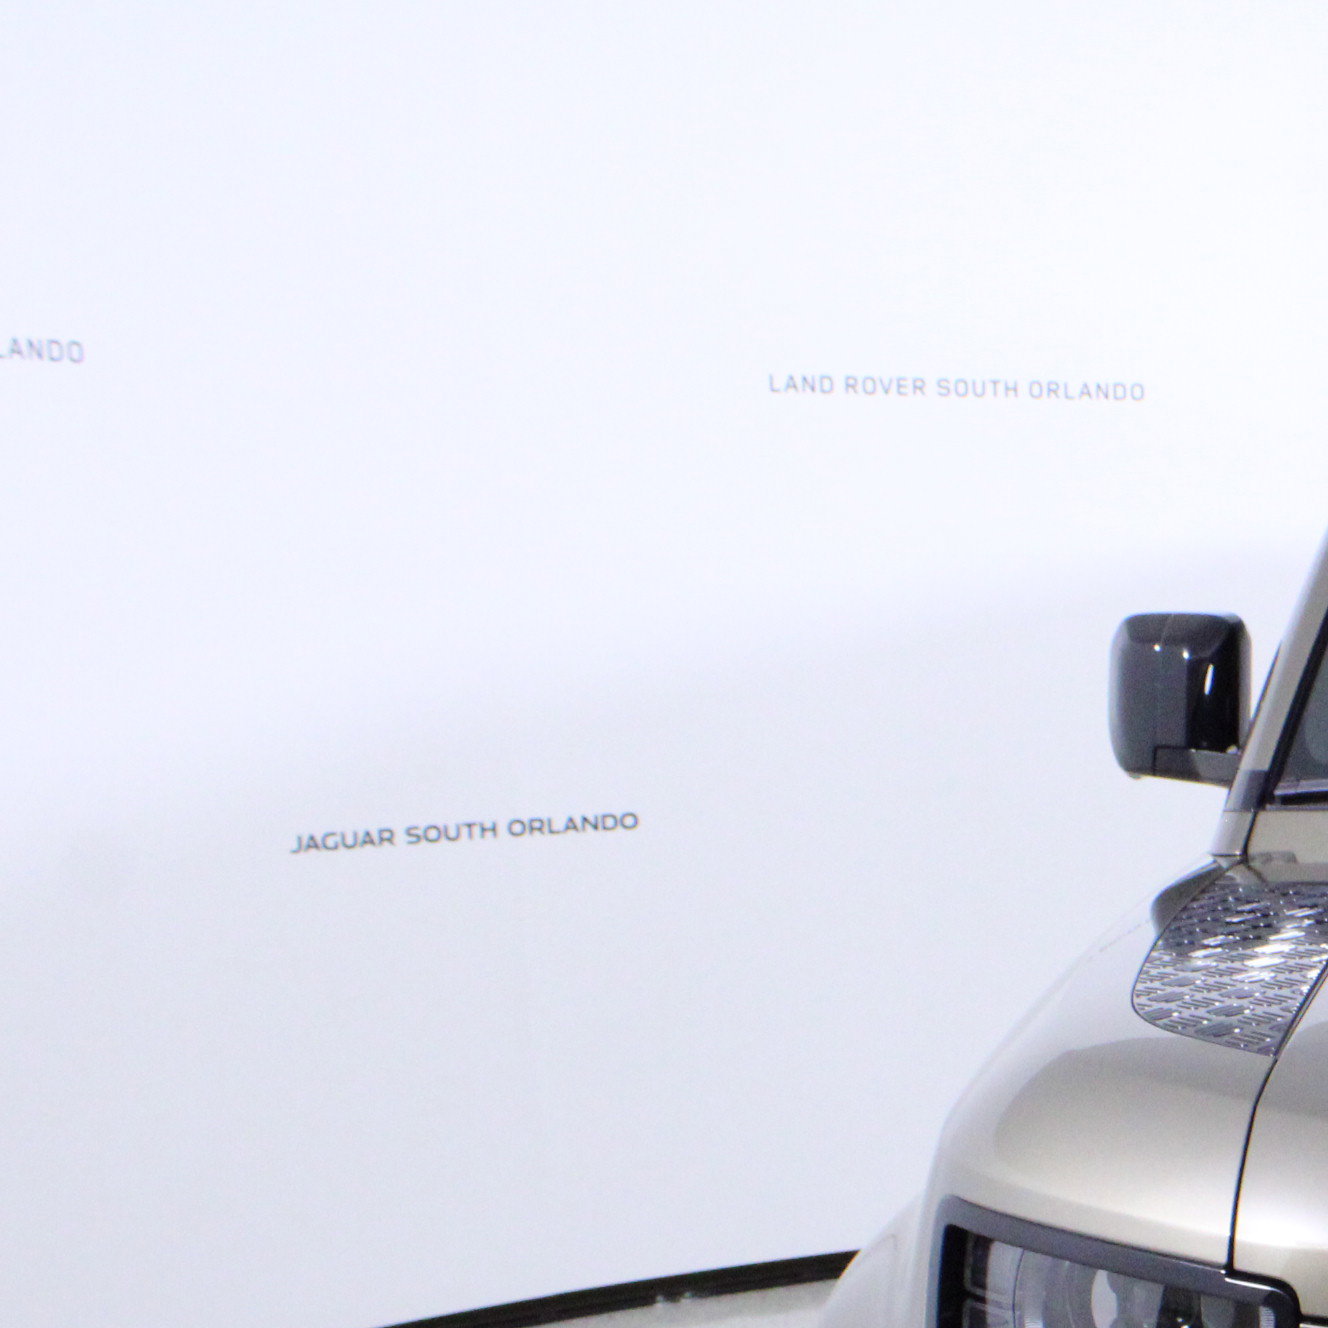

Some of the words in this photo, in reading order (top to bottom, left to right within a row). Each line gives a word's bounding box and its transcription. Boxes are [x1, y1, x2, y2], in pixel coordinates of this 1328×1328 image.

[0, 337, 84, 363] ANDO
[767, 373, 835, 395] LAND
[844, 375, 926, 397] ROVER
[935, 377, 1019, 399] SOUTH
[1027, 380, 1146, 402] ORLANDO
[290, 827, 396, 854] JAGUAR
[404, 821, 499, 846] SOUTH
[507, 812, 641, 838] ORLANDO
